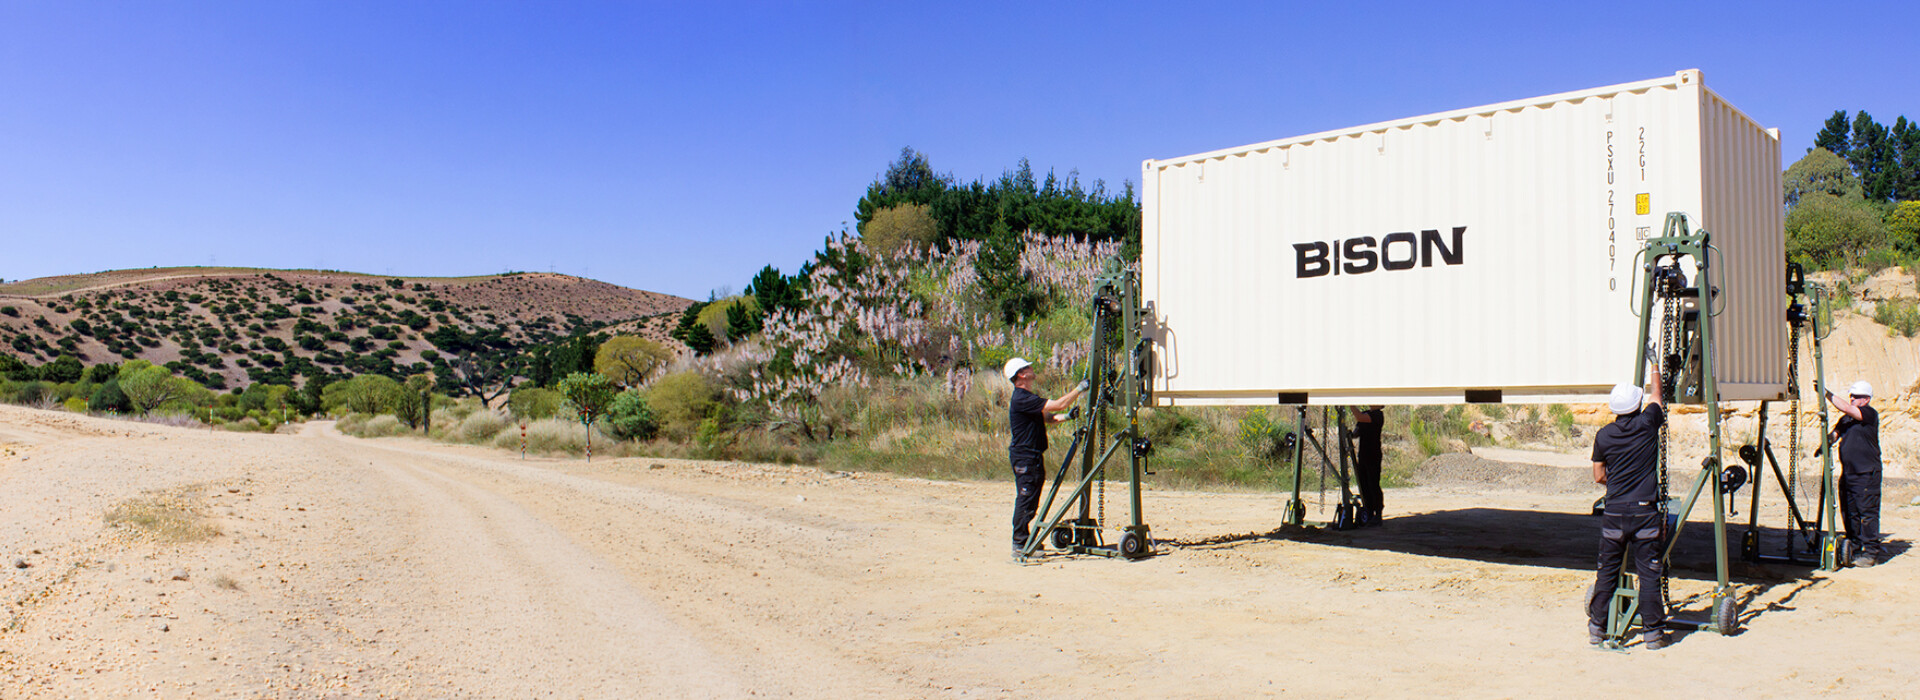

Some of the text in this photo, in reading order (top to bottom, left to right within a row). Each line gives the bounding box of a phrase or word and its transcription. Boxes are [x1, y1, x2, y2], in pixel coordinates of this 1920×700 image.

[1292, 226, 1468, 279] BISON
[1607, 190, 1615, 271] 270407
[1609, 278, 1616, 291] 0
